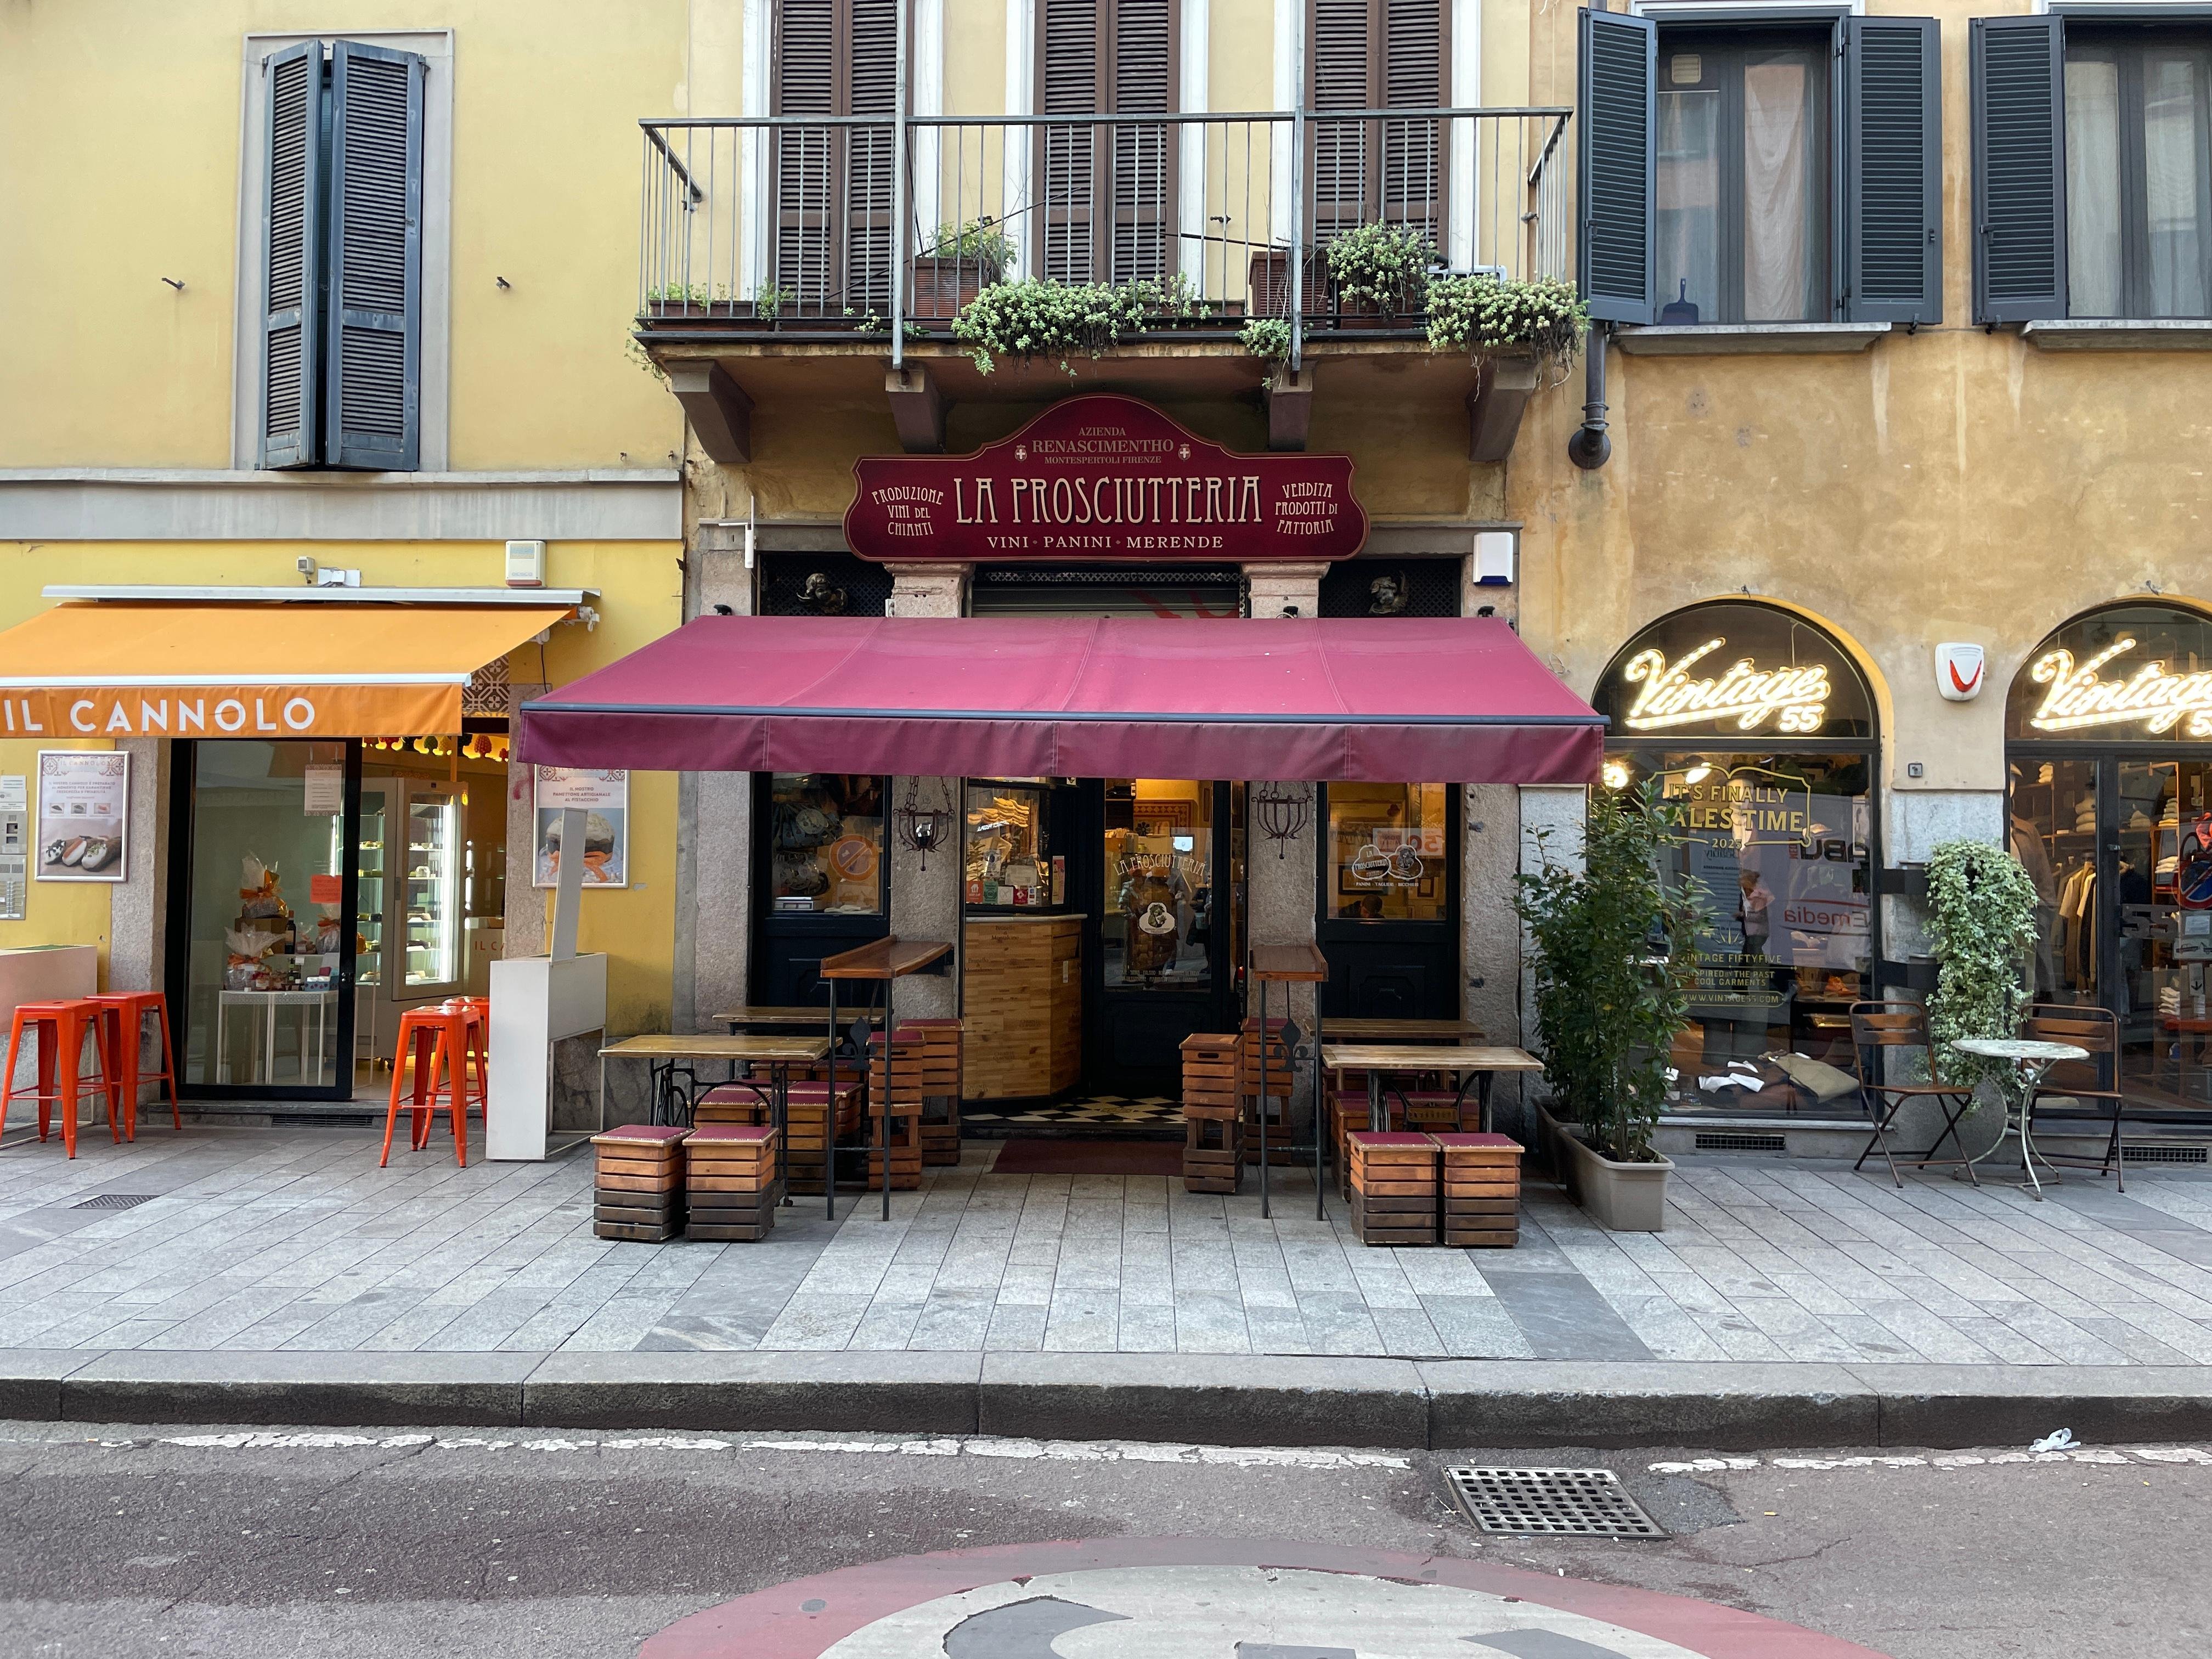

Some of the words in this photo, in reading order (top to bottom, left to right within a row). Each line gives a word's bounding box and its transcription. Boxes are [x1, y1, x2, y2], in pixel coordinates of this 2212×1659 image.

[1079, 427, 1126, 436] AZIENDA
[1032, 439, 1174, 453] RENASCIMENTHO
[1044, 456, 1120, 464] MONTESPERTOLI
[872, 486, 944, 505] PRODUZIONE
[1282, 482, 1333, 498] VENDITA
[953, 477, 998, 523] LA
[1011, 476, 1262, 523] PROSCIUTTERIA
[887, 505, 910, 518] VINI
[915, 507, 931, 518] DEL
[1275, 501, 1325, 515] PRODOTTI
[1329, 503, 1338, 515] DI
[888, 522, 934, 536] CHIANTI
[1277, 519, 1335, 535] FATTORIA
[987, 537, 1029, 548] VINI
[1043, 536, 1112, 548] PANINI
[1126, 536, 1223, 549] MERENDE
[1624, 637, 1831, 730] Vintage
[4, 699, 43, 731] IL
[70, 698, 315, 731] CANNOLO
[1779, 703, 1825, 732] 55
[1669, 783, 1703, 800] IT'S
[1710, 785, 1788, 804] FINALLY
[1741, 809, 1804, 832] TIME
[1712, 838, 1742, 849] 2025
[1113, 860, 1128, 876] LA
[1130, 854, 1206, 876] PROSCIUTTERIA
[1729, 953, 1782, 964] FIFTYFIVE
[1719, 978, 1766, 986] GARMENTS
